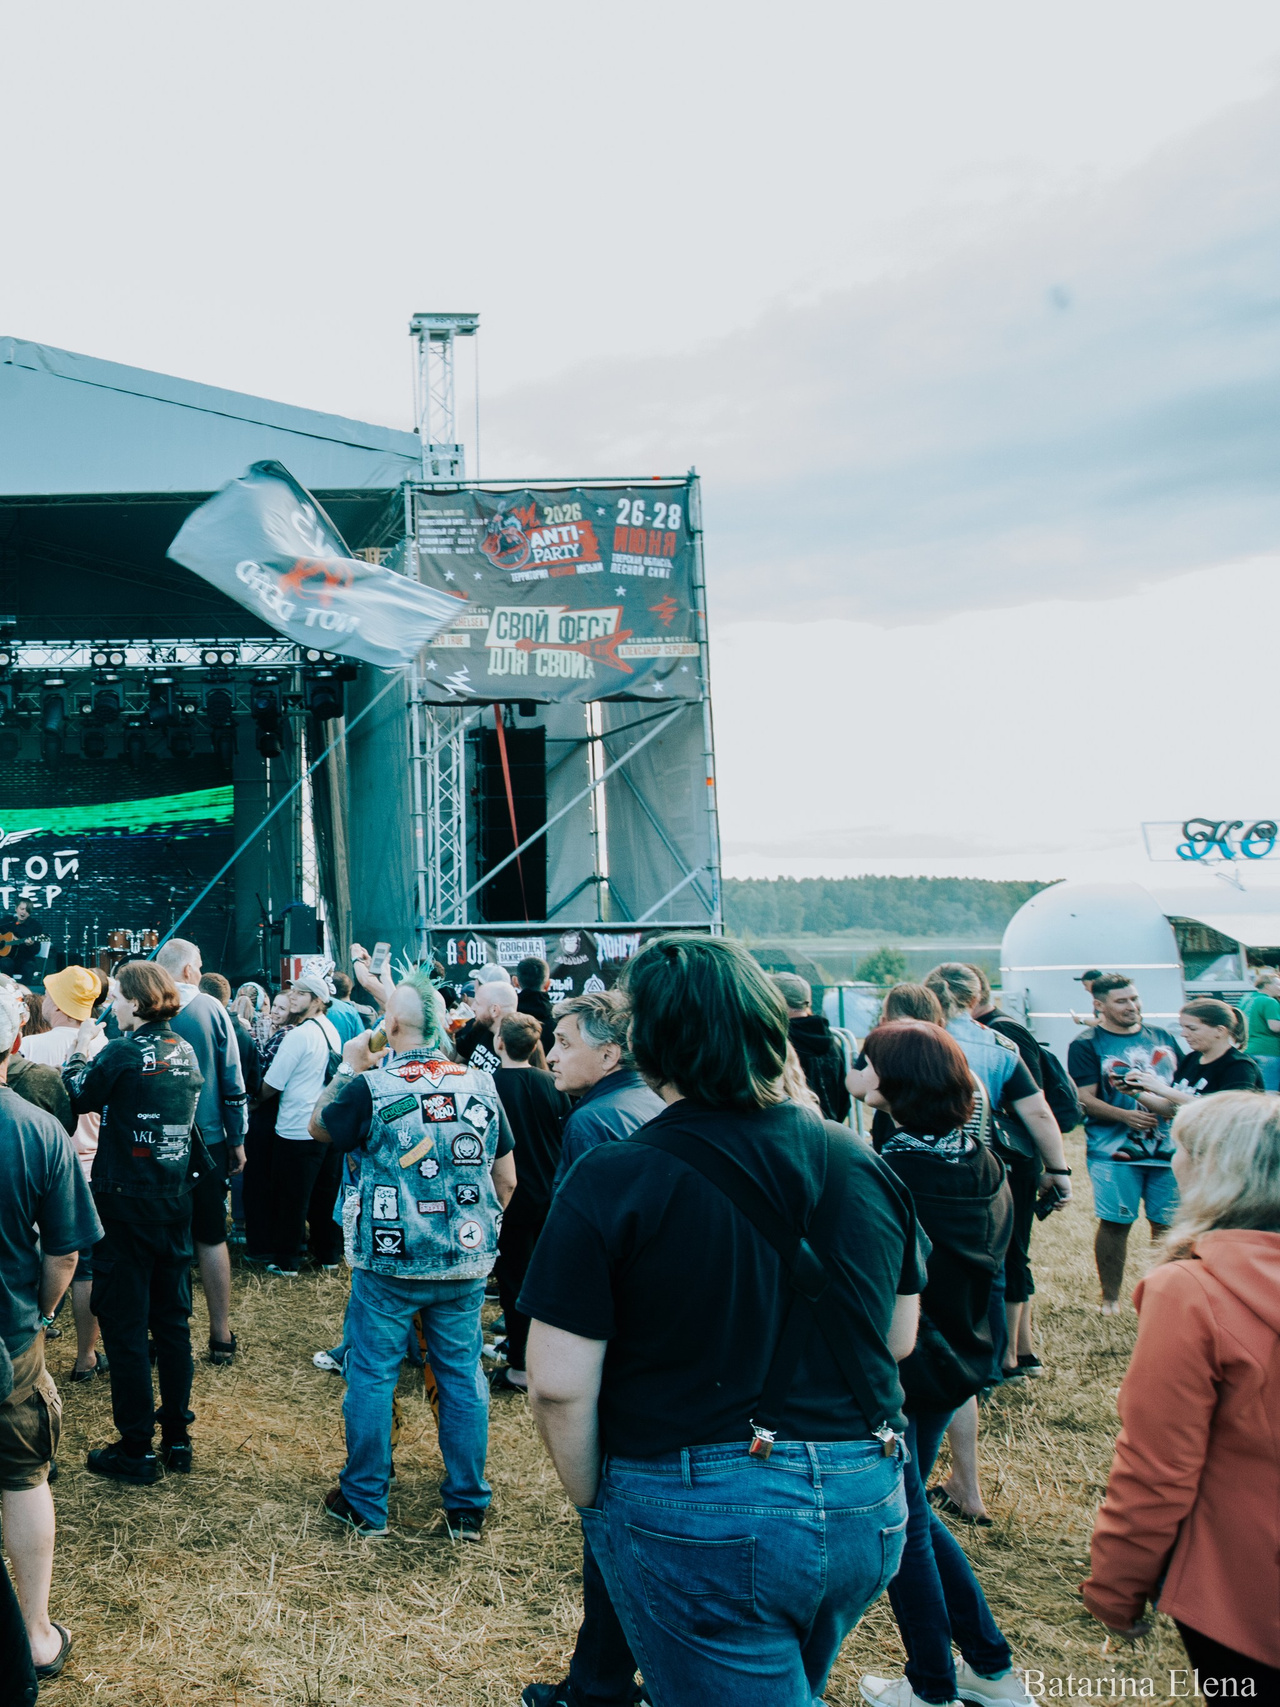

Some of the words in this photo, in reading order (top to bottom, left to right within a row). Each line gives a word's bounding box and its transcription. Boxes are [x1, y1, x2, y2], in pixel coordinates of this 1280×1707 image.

[543, 502, 583, 525] 2026
[616, 498, 681, 530] 26-28
[530, 525, 585, 548] ANTI-
[613, 526, 677, 557] ИЮНЯ
[532, 543, 580, 563] PARTY
[496, 609, 549, 642] СВОЙ
[558, 615, 612, 645] ФЕСТ
[488, 648, 529, 676] ДЛЯ
[499, 940, 542, 953] СВОБОДА
